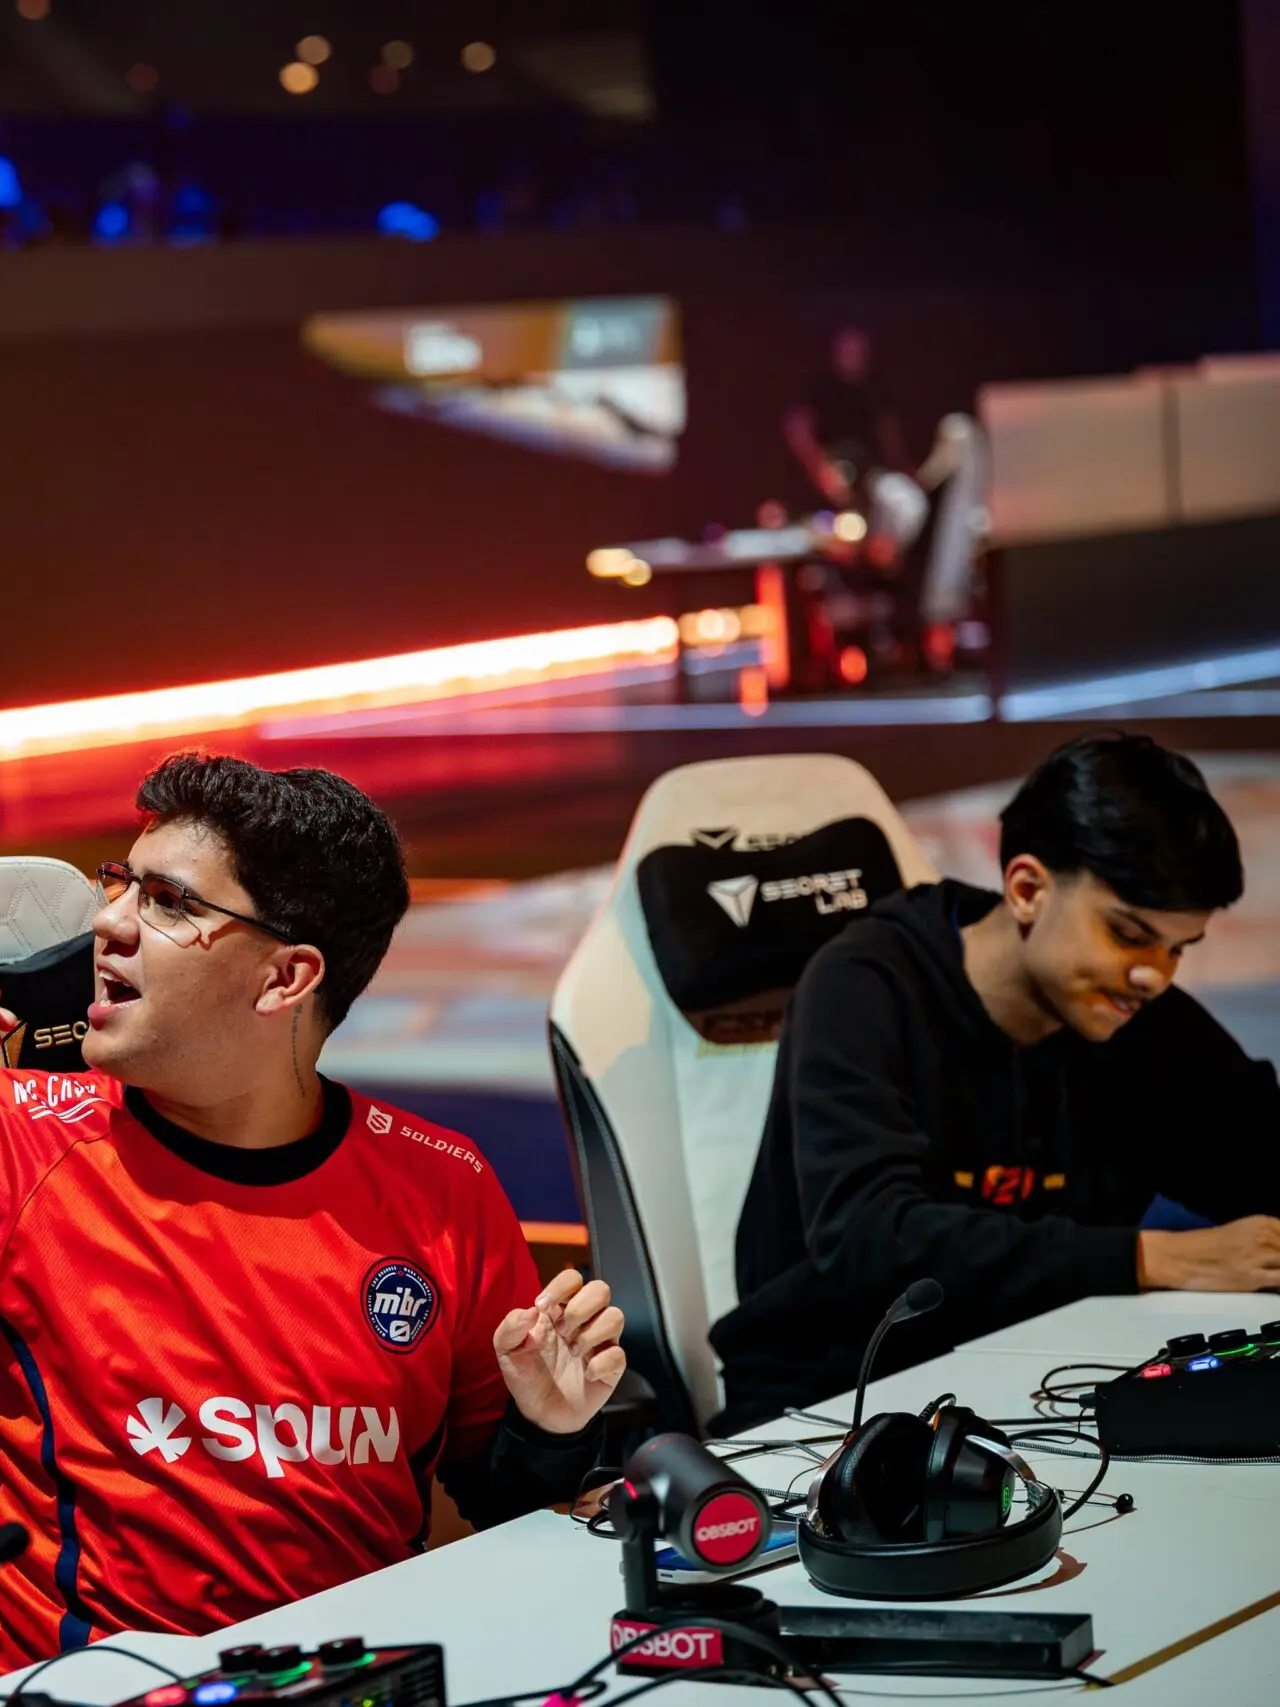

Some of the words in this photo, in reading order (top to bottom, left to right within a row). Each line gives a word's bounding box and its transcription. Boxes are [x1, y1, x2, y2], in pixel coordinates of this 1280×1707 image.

[33, 1020, 89, 1049] SEC
[400, 1126, 484, 1174] SOLDIERS
[373, 1286, 428, 1318] mibr
[696, 1517, 759, 1542] OBSBOT
